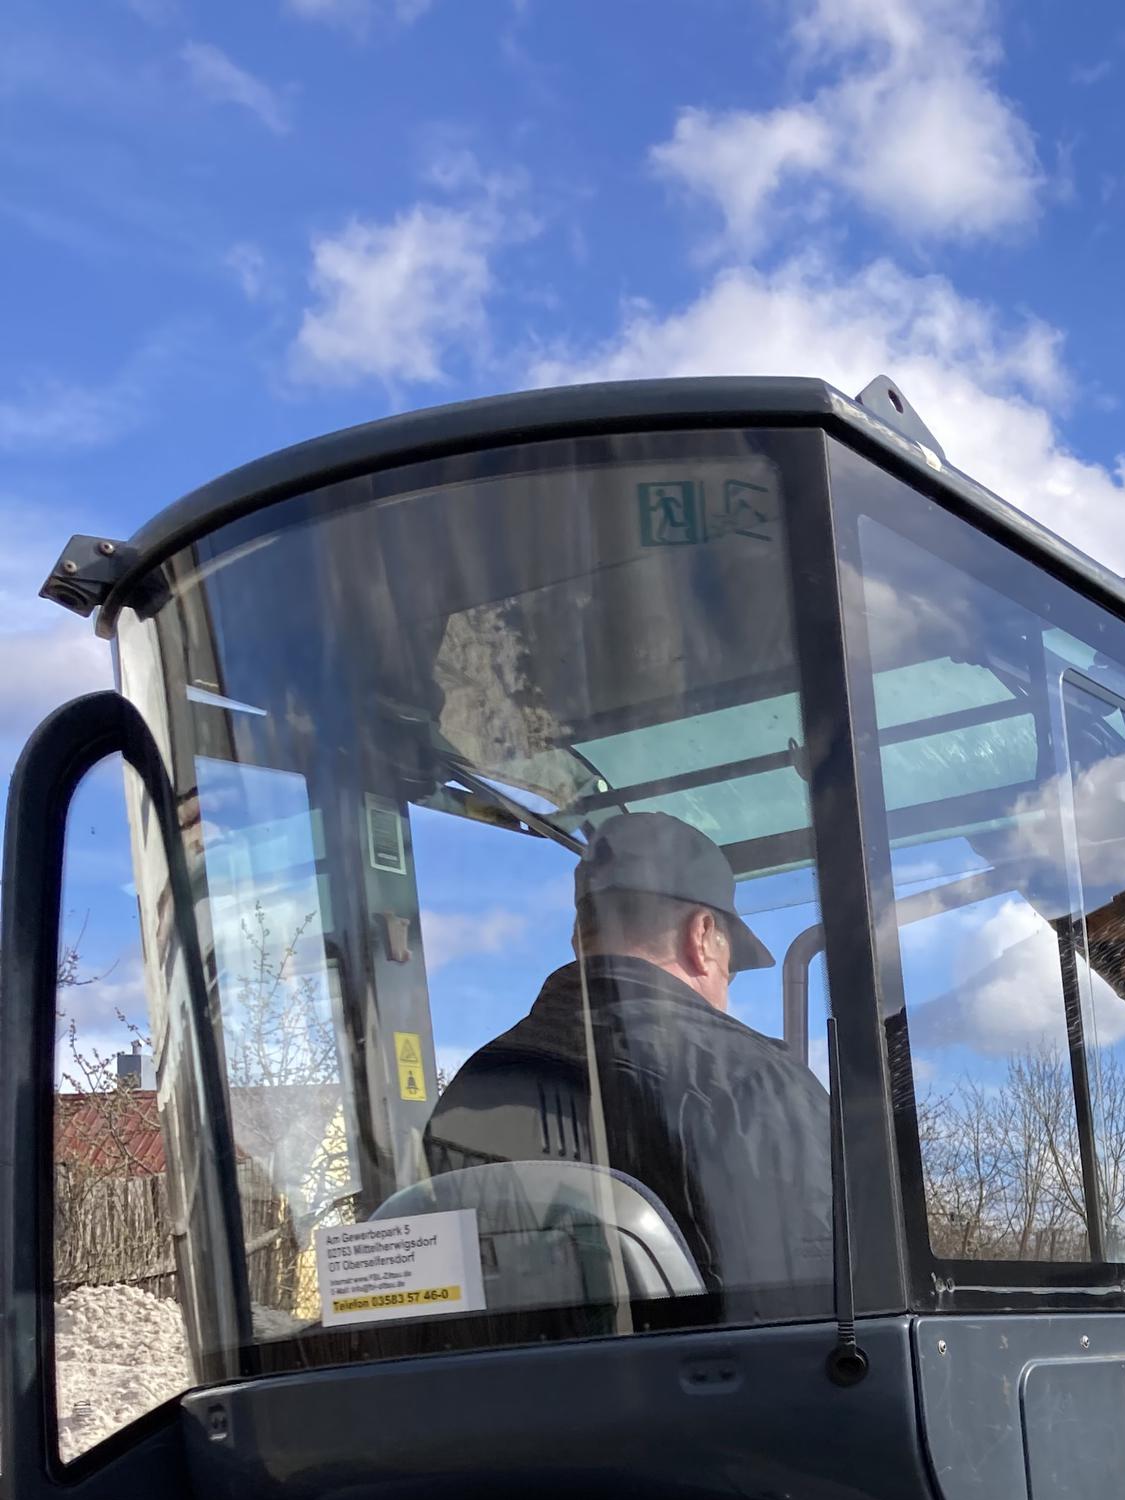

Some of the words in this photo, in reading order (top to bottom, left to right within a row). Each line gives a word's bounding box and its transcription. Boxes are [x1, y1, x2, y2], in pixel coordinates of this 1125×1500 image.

[326, 1235, 340, 1245] Am
[342, 1225, 402, 1243] Gewerbepark
[404, 1224, 411, 1235] 5
[328, 1261, 341, 1273] OT
[333, 1299, 369, 1311] Telefon
[371, 1294, 404, 1307] 03583
[407, 1291, 420, 1303] 57
[423, 1288, 449, 1300] 46-0
